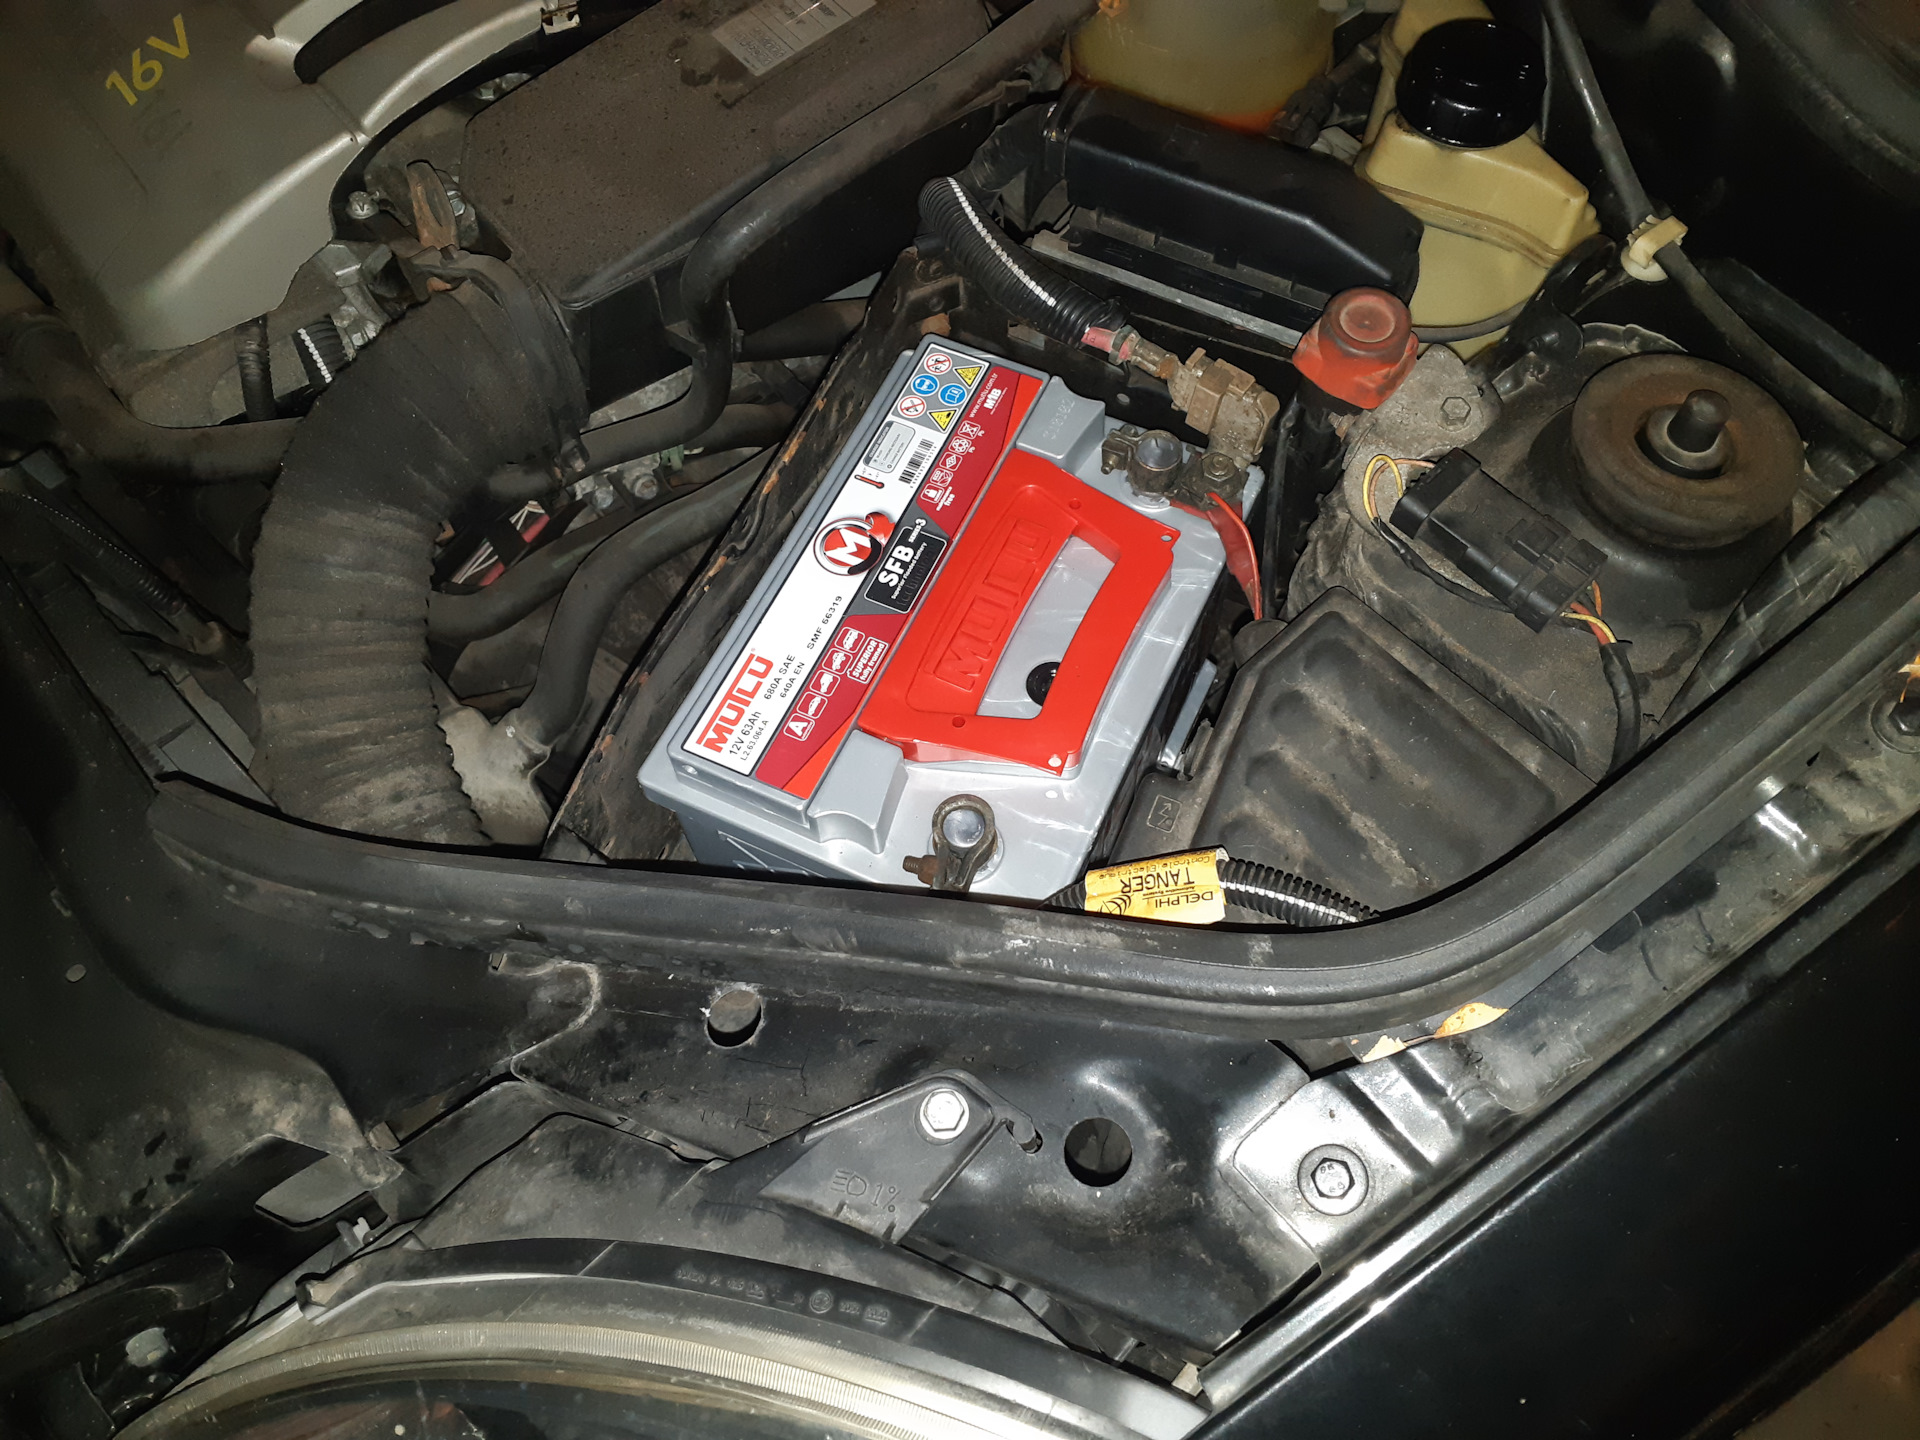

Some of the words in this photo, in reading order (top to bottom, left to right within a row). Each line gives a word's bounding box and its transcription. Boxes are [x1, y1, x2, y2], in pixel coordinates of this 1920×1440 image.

[105, 12, 190, 106] 16V
[968, 372, 998, 418] www.mutlu.com.tr
[942, 492, 956, 506] free
[914, 516, 927, 527] 3
[824, 527, 872, 564] M
[876, 542, 915, 588] SFB
[890, 578, 906, 599] Superior
[913, 541, 928, 560] Battery
[927, 519, 1054, 691] MUTLU
[805, 625, 823, 650] SMF
[850, 639, 878, 677] SUPERIOR
[858, 665, 873, 680] fully
[866, 642, 886, 667] framed
[779, 675, 796, 698] 640A
[793, 661, 805, 675] EN
[695, 652, 775, 753] MUTLU
[727, 735, 745, 756] 12V
[740, 709, 761, 736] 63Ah
[762, 674, 782, 700] 680A
[778, 653, 795, 675] SAE
[787, 721, 809, 736] A
[1120, 867, 1195, 894] TANGER
[1155, 891, 1214, 909] DELPHI
[870, 1183, 901, 1213] 1%
